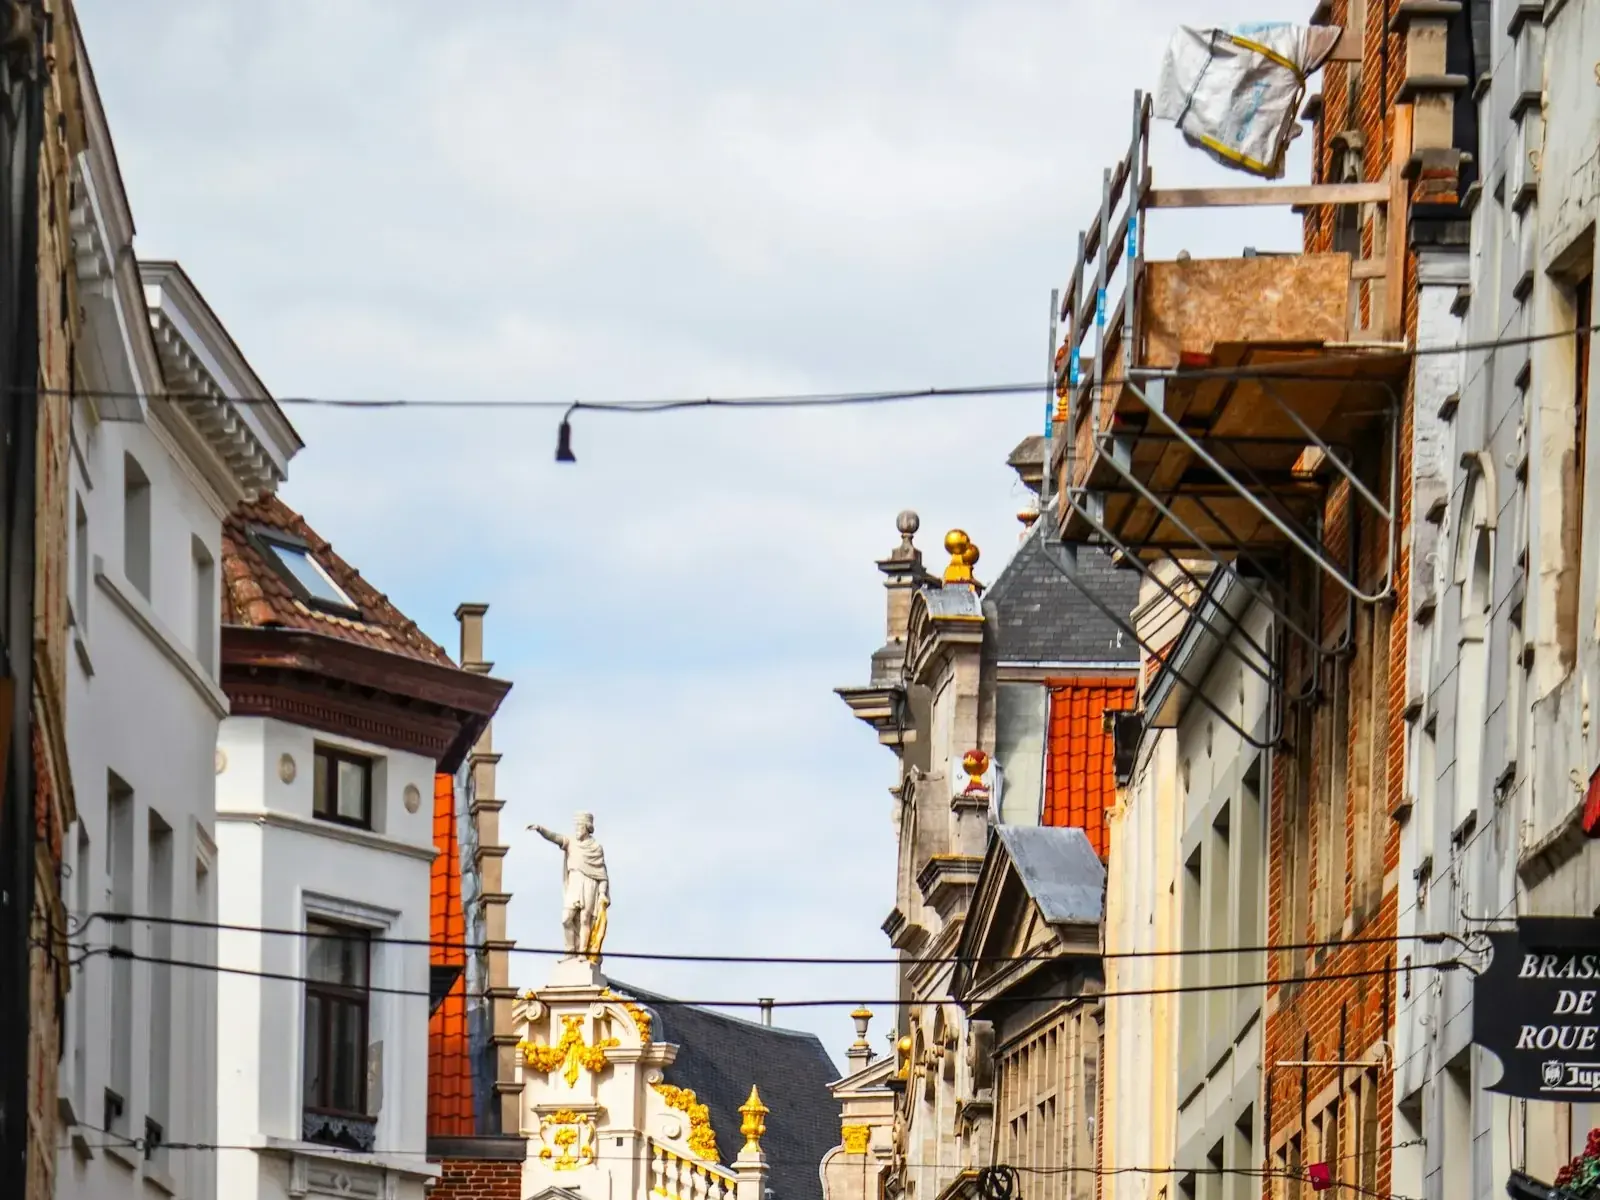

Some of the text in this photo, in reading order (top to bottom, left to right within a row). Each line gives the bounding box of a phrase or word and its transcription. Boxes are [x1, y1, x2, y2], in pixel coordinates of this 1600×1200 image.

[1518, 954, 1600, 979] BRAS
[1553, 990, 1597, 1015] DE
[1515, 1024, 1599, 1050] ROUE
